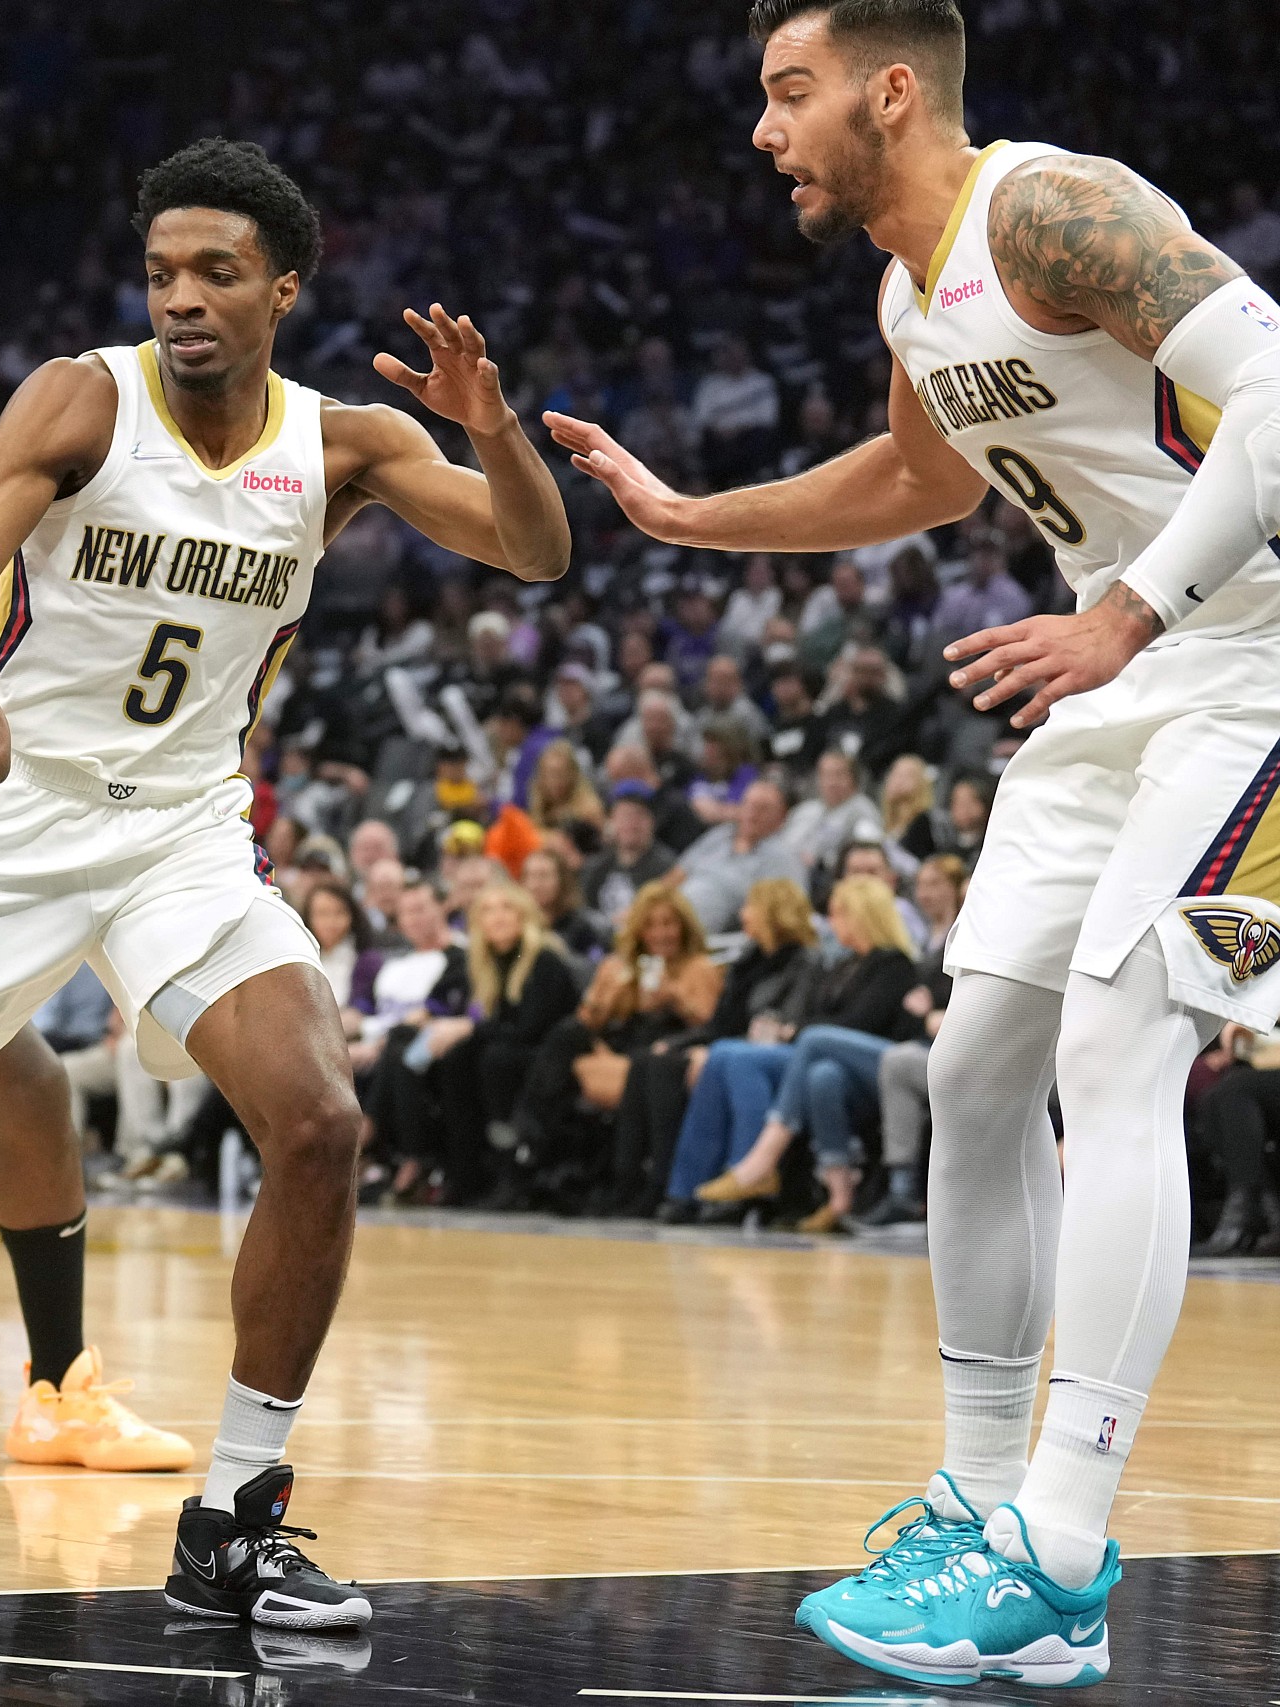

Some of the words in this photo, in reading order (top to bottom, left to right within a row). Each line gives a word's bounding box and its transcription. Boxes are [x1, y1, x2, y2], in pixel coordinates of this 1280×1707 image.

[938, 277, 984, 310] ibotta
[929, 358, 1058, 432] ORLEANS
[242, 470, 303, 494] ibotta
[985, 444, 1087, 547] 9
[70, 525, 166, 589] NEW
[165, 537, 299, 611] ORLEANS
[122, 620, 205, 727] 5
